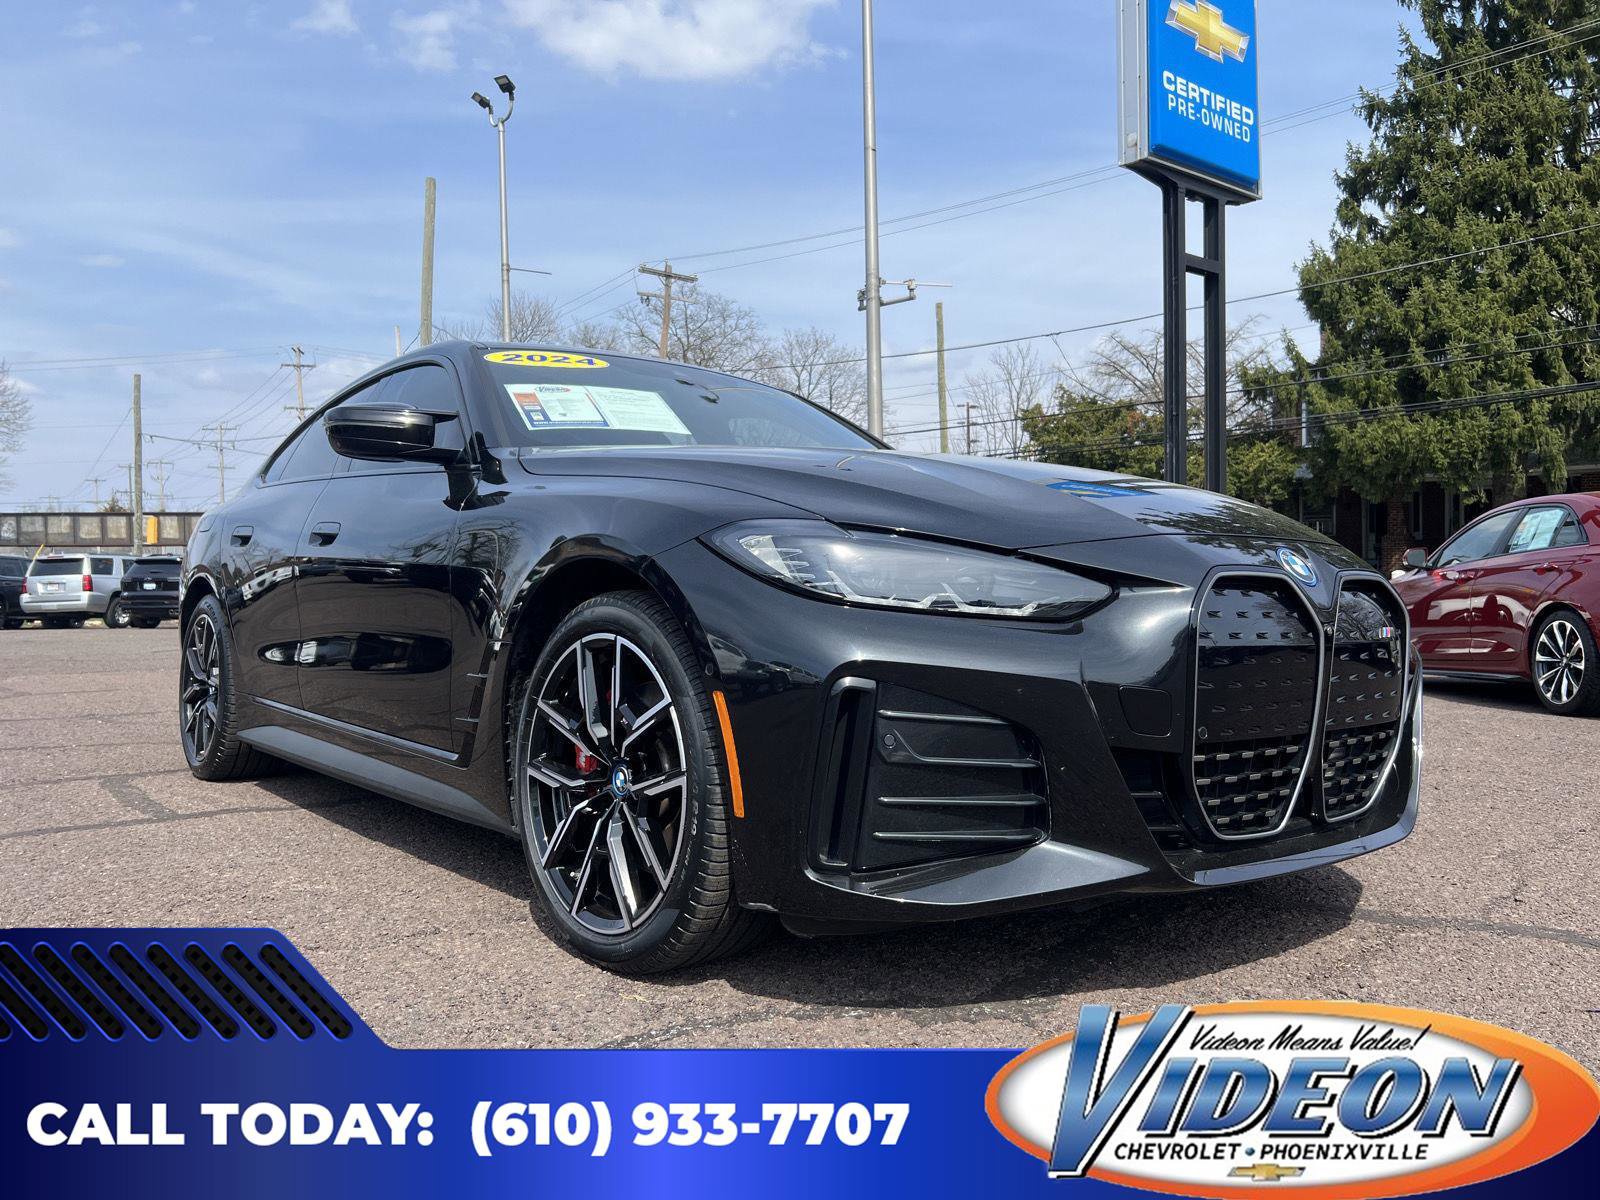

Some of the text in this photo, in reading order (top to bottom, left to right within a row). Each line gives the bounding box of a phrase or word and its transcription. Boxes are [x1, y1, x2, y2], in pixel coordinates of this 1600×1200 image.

[1162, 70, 1254, 126] CERTIFIED
[1167, 93, 1251, 143] PRE-OWNED
[502, 353, 597, 366] 2024
